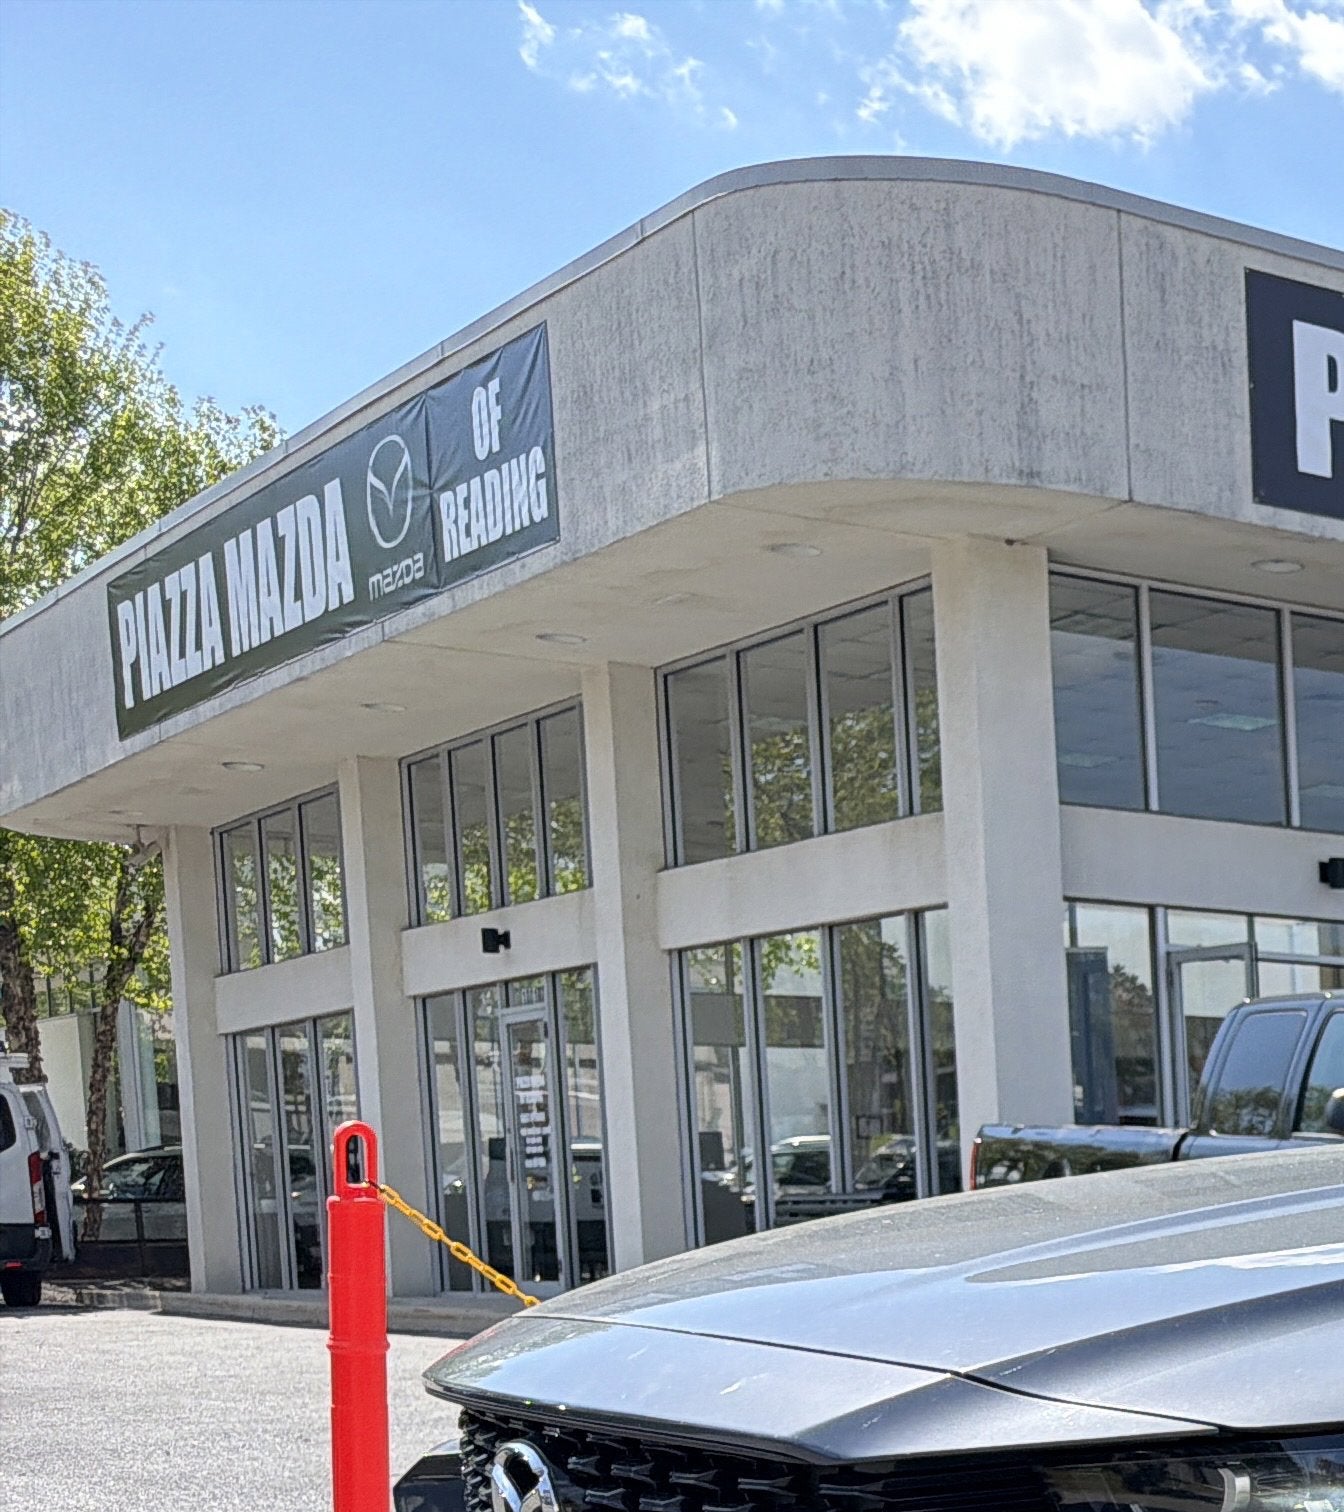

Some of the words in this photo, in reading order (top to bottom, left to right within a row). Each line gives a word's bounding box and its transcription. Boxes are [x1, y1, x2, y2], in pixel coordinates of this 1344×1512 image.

[470, 377, 503, 461] OF
[440, 445, 549, 563] READING
[117, 551, 226, 709] PIAZZA
[223, 477, 355, 659] MAZDA
[367, 552, 425, 601] mazda
